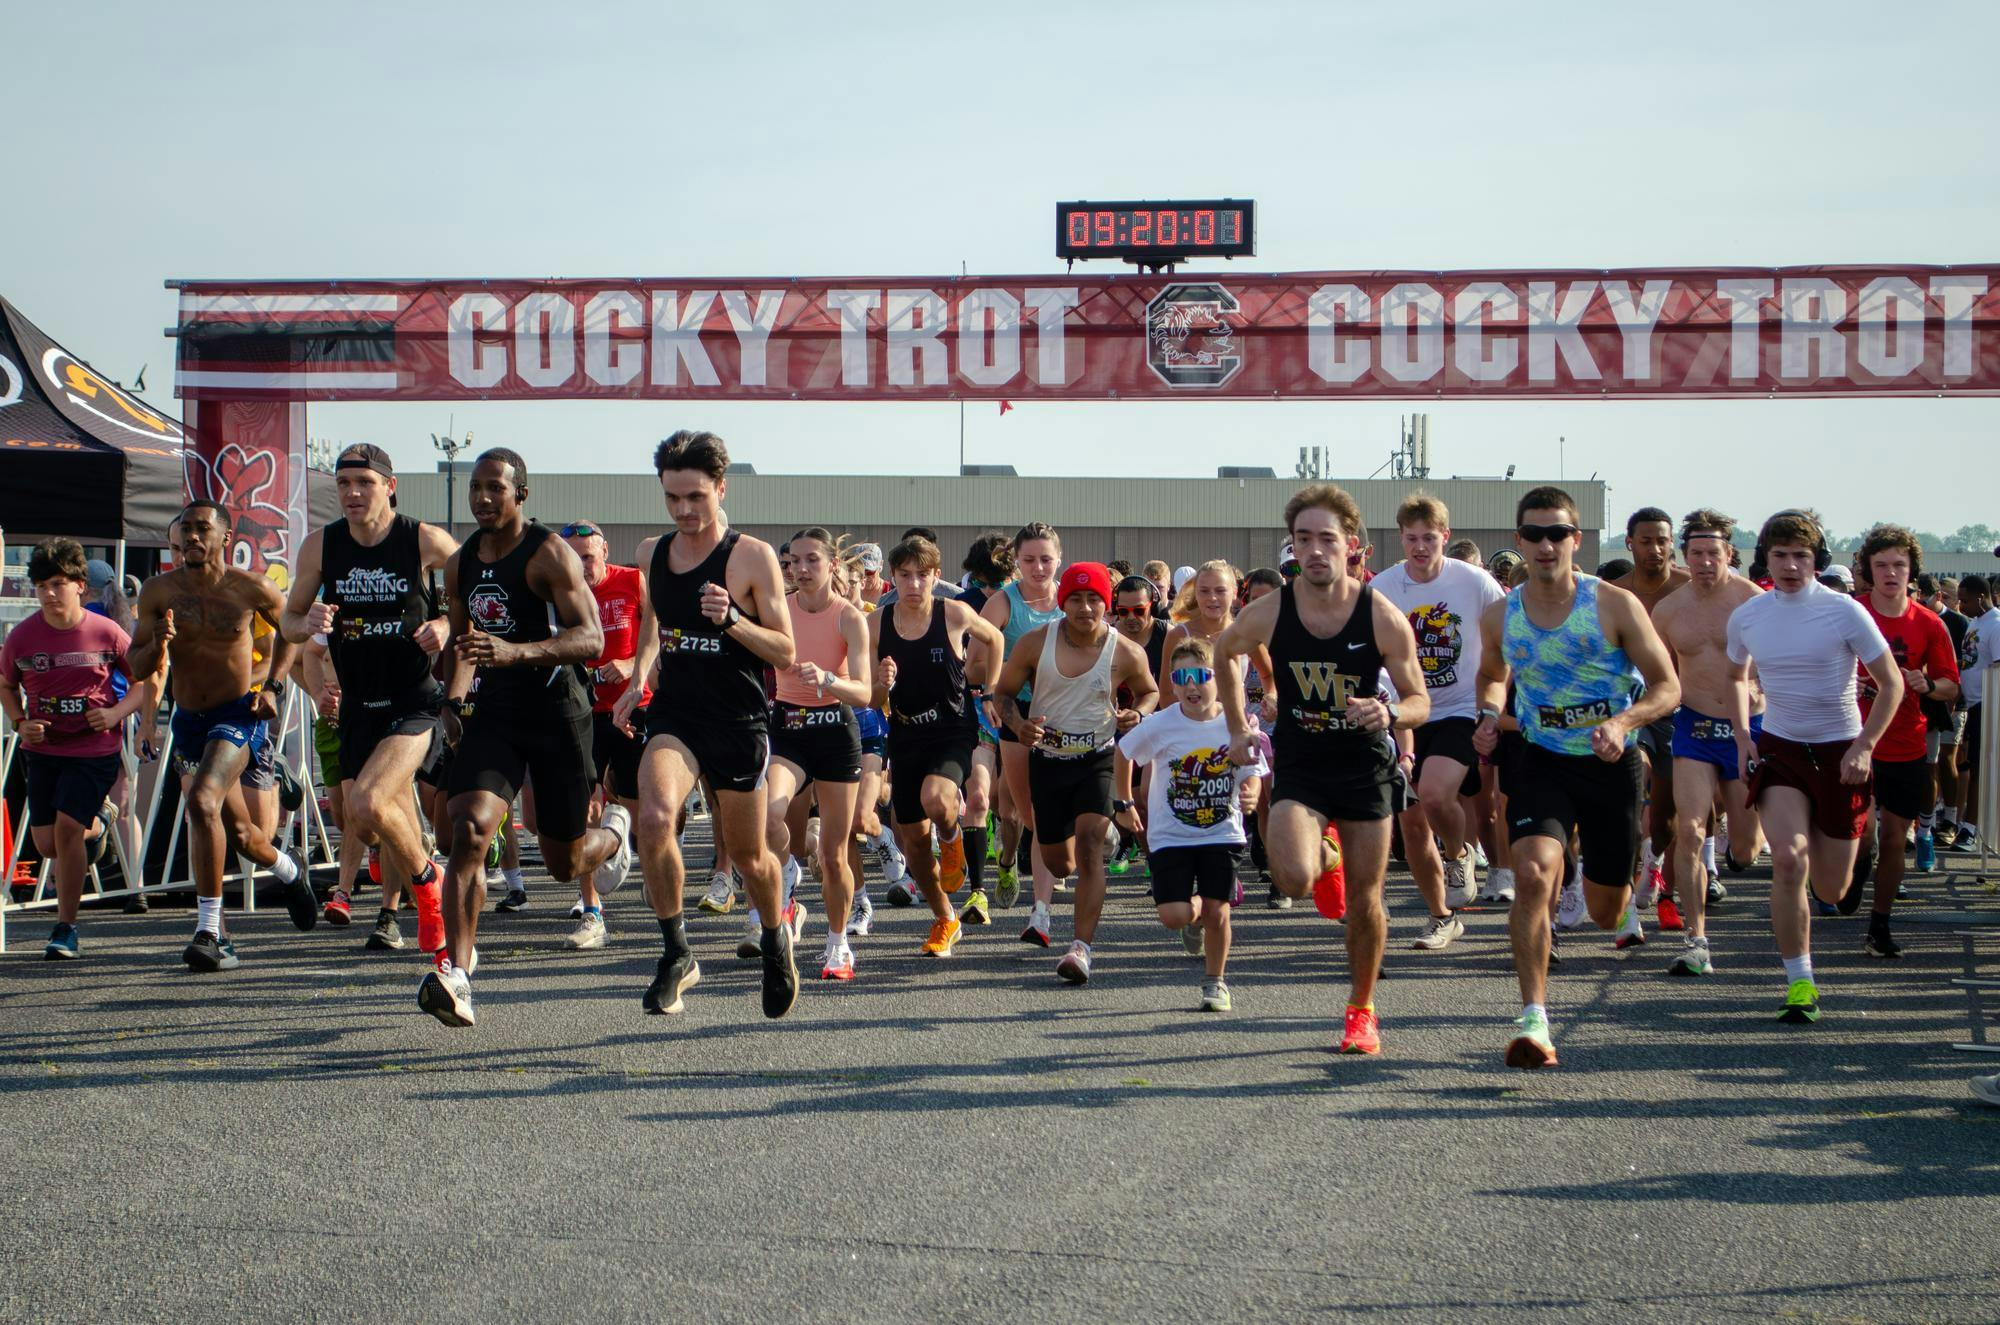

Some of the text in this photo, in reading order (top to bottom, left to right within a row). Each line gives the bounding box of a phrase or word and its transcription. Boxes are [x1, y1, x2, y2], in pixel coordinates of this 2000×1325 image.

[1069, 210, 1243, 247] 09:20:01
[1308, 275, 1988, 382] COCKY TROT
[448, 287, 1079, 388] COCKY TROT
[348, 567, 396, 581] Strictly
[336, 579, 408, 594] RUNNING
[375, 594, 396, 602] TEAM
[362, 621, 402, 635] 2497
[679, 636, 721, 652] 2725
[1433, 647, 1455, 657] TROT
[60, 699, 82, 713] 535
[806, 710, 841, 725] 2701
[1564, 702, 1608, 726] 8542
[1061, 734, 1093, 749] 8568
[1198, 776, 1230, 796] 2090
[1174, 798, 1207, 810] COCKY
[1196, 808, 1214, 820] 5K
